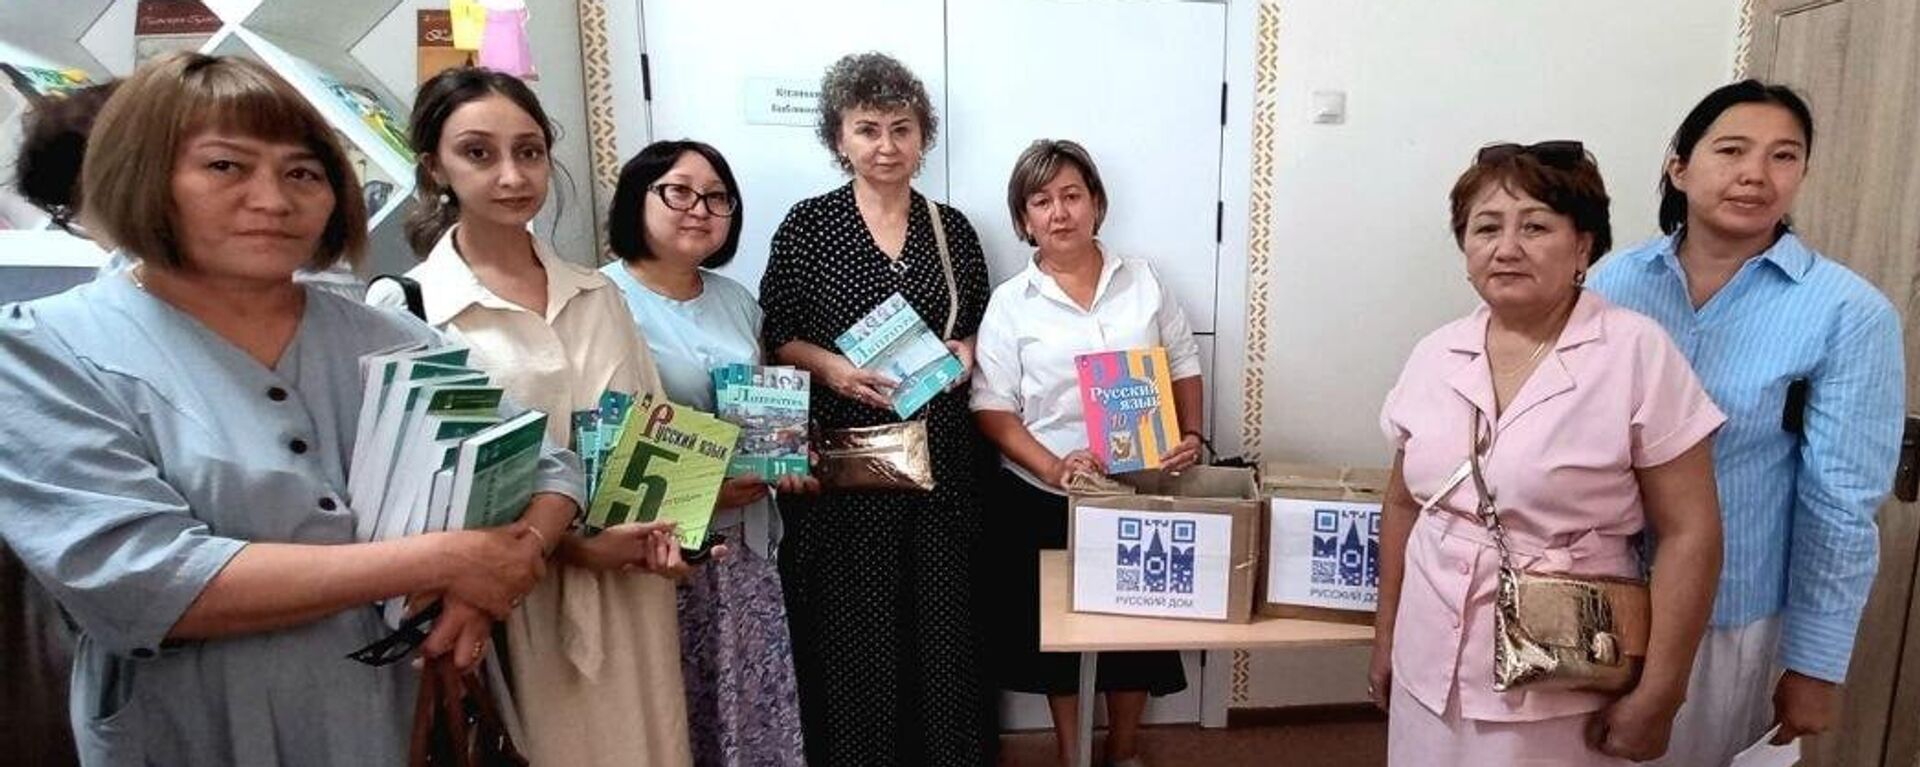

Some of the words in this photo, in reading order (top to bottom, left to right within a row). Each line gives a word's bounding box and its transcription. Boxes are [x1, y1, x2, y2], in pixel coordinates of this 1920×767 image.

[1089, 376, 1160, 405] Русский
[639, 403, 700, 451] Русский
[1111, 412, 1127, 429] 10
[774, 461, 788, 475] 11
[605, 440, 681, 524] 5
[1115, 595, 1166, 606] РУССКИЙ
[1168, 597, 1193, 609] ДОМ
[1310, 588, 1360, 602] РУССКИЙ
